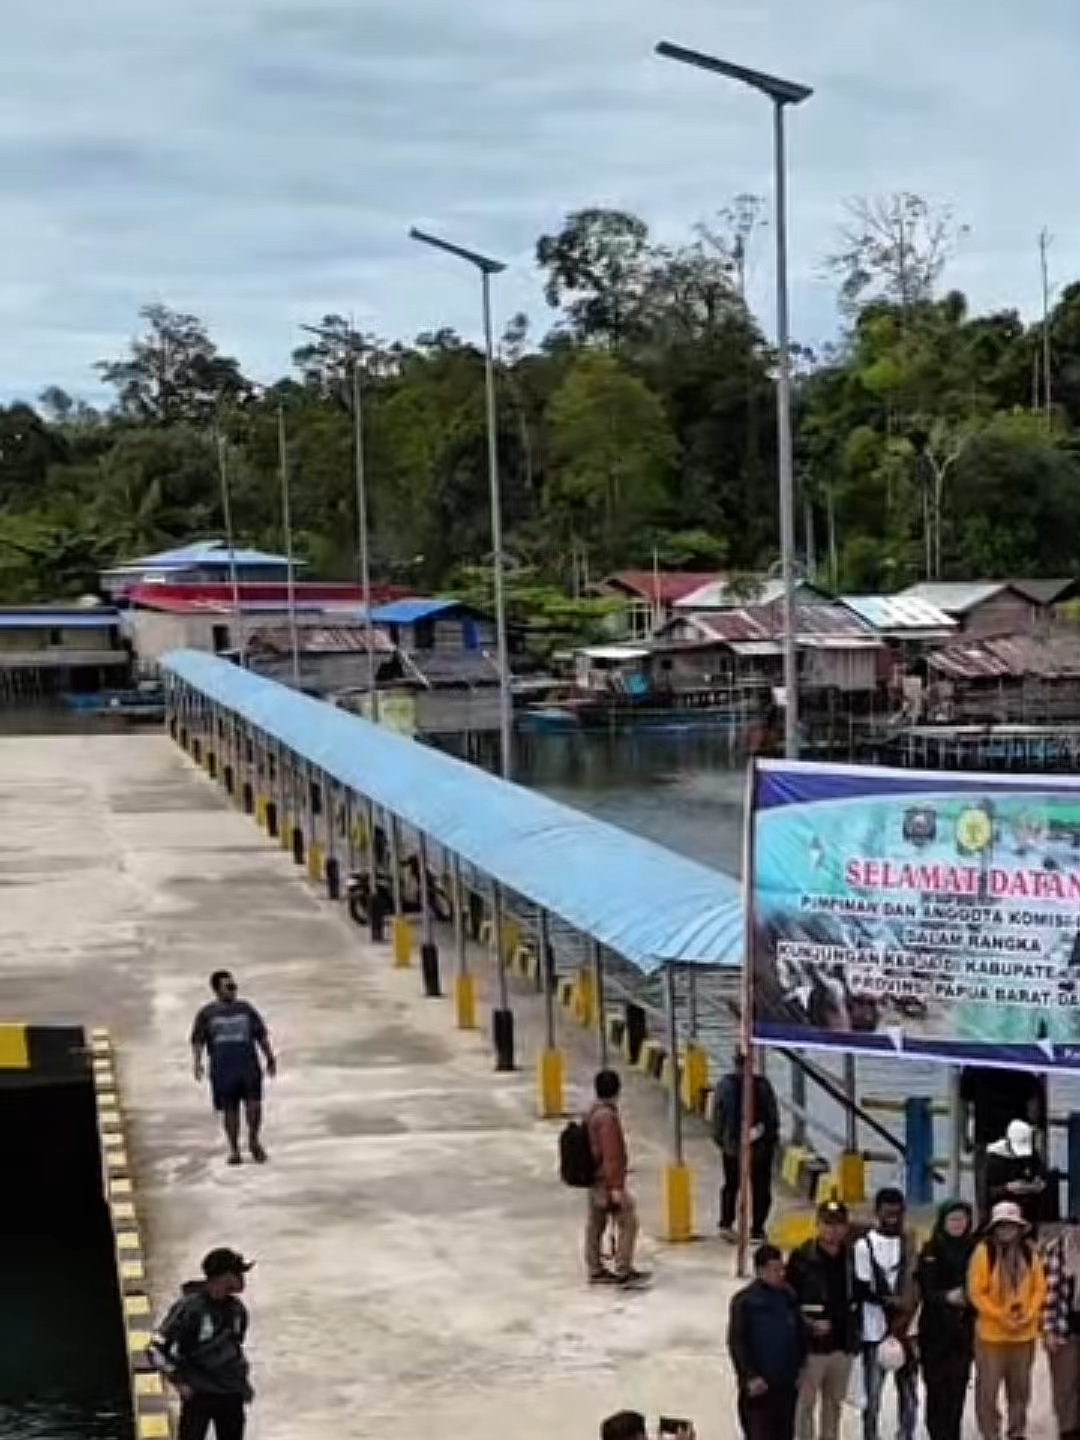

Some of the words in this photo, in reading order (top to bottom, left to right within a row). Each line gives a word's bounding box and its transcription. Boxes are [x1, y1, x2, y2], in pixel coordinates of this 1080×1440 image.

[845, 859, 979, 893] SELAMAT
[801, 895, 877, 915] PIMPINAN
[883, 901, 916, 917] DAN
[923, 904, 1002, 924] ANGGOTA
[1007, 909, 1069, 928] KOMISI
[906, 926, 962, 945] DALAM
[967, 934, 1042, 952] RANGKA
[777, 943, 880, 965] KUNJUNGAN
[934, 981, 989, 999] PAPUA
[994, 986, 1050, 1005] BARAT
